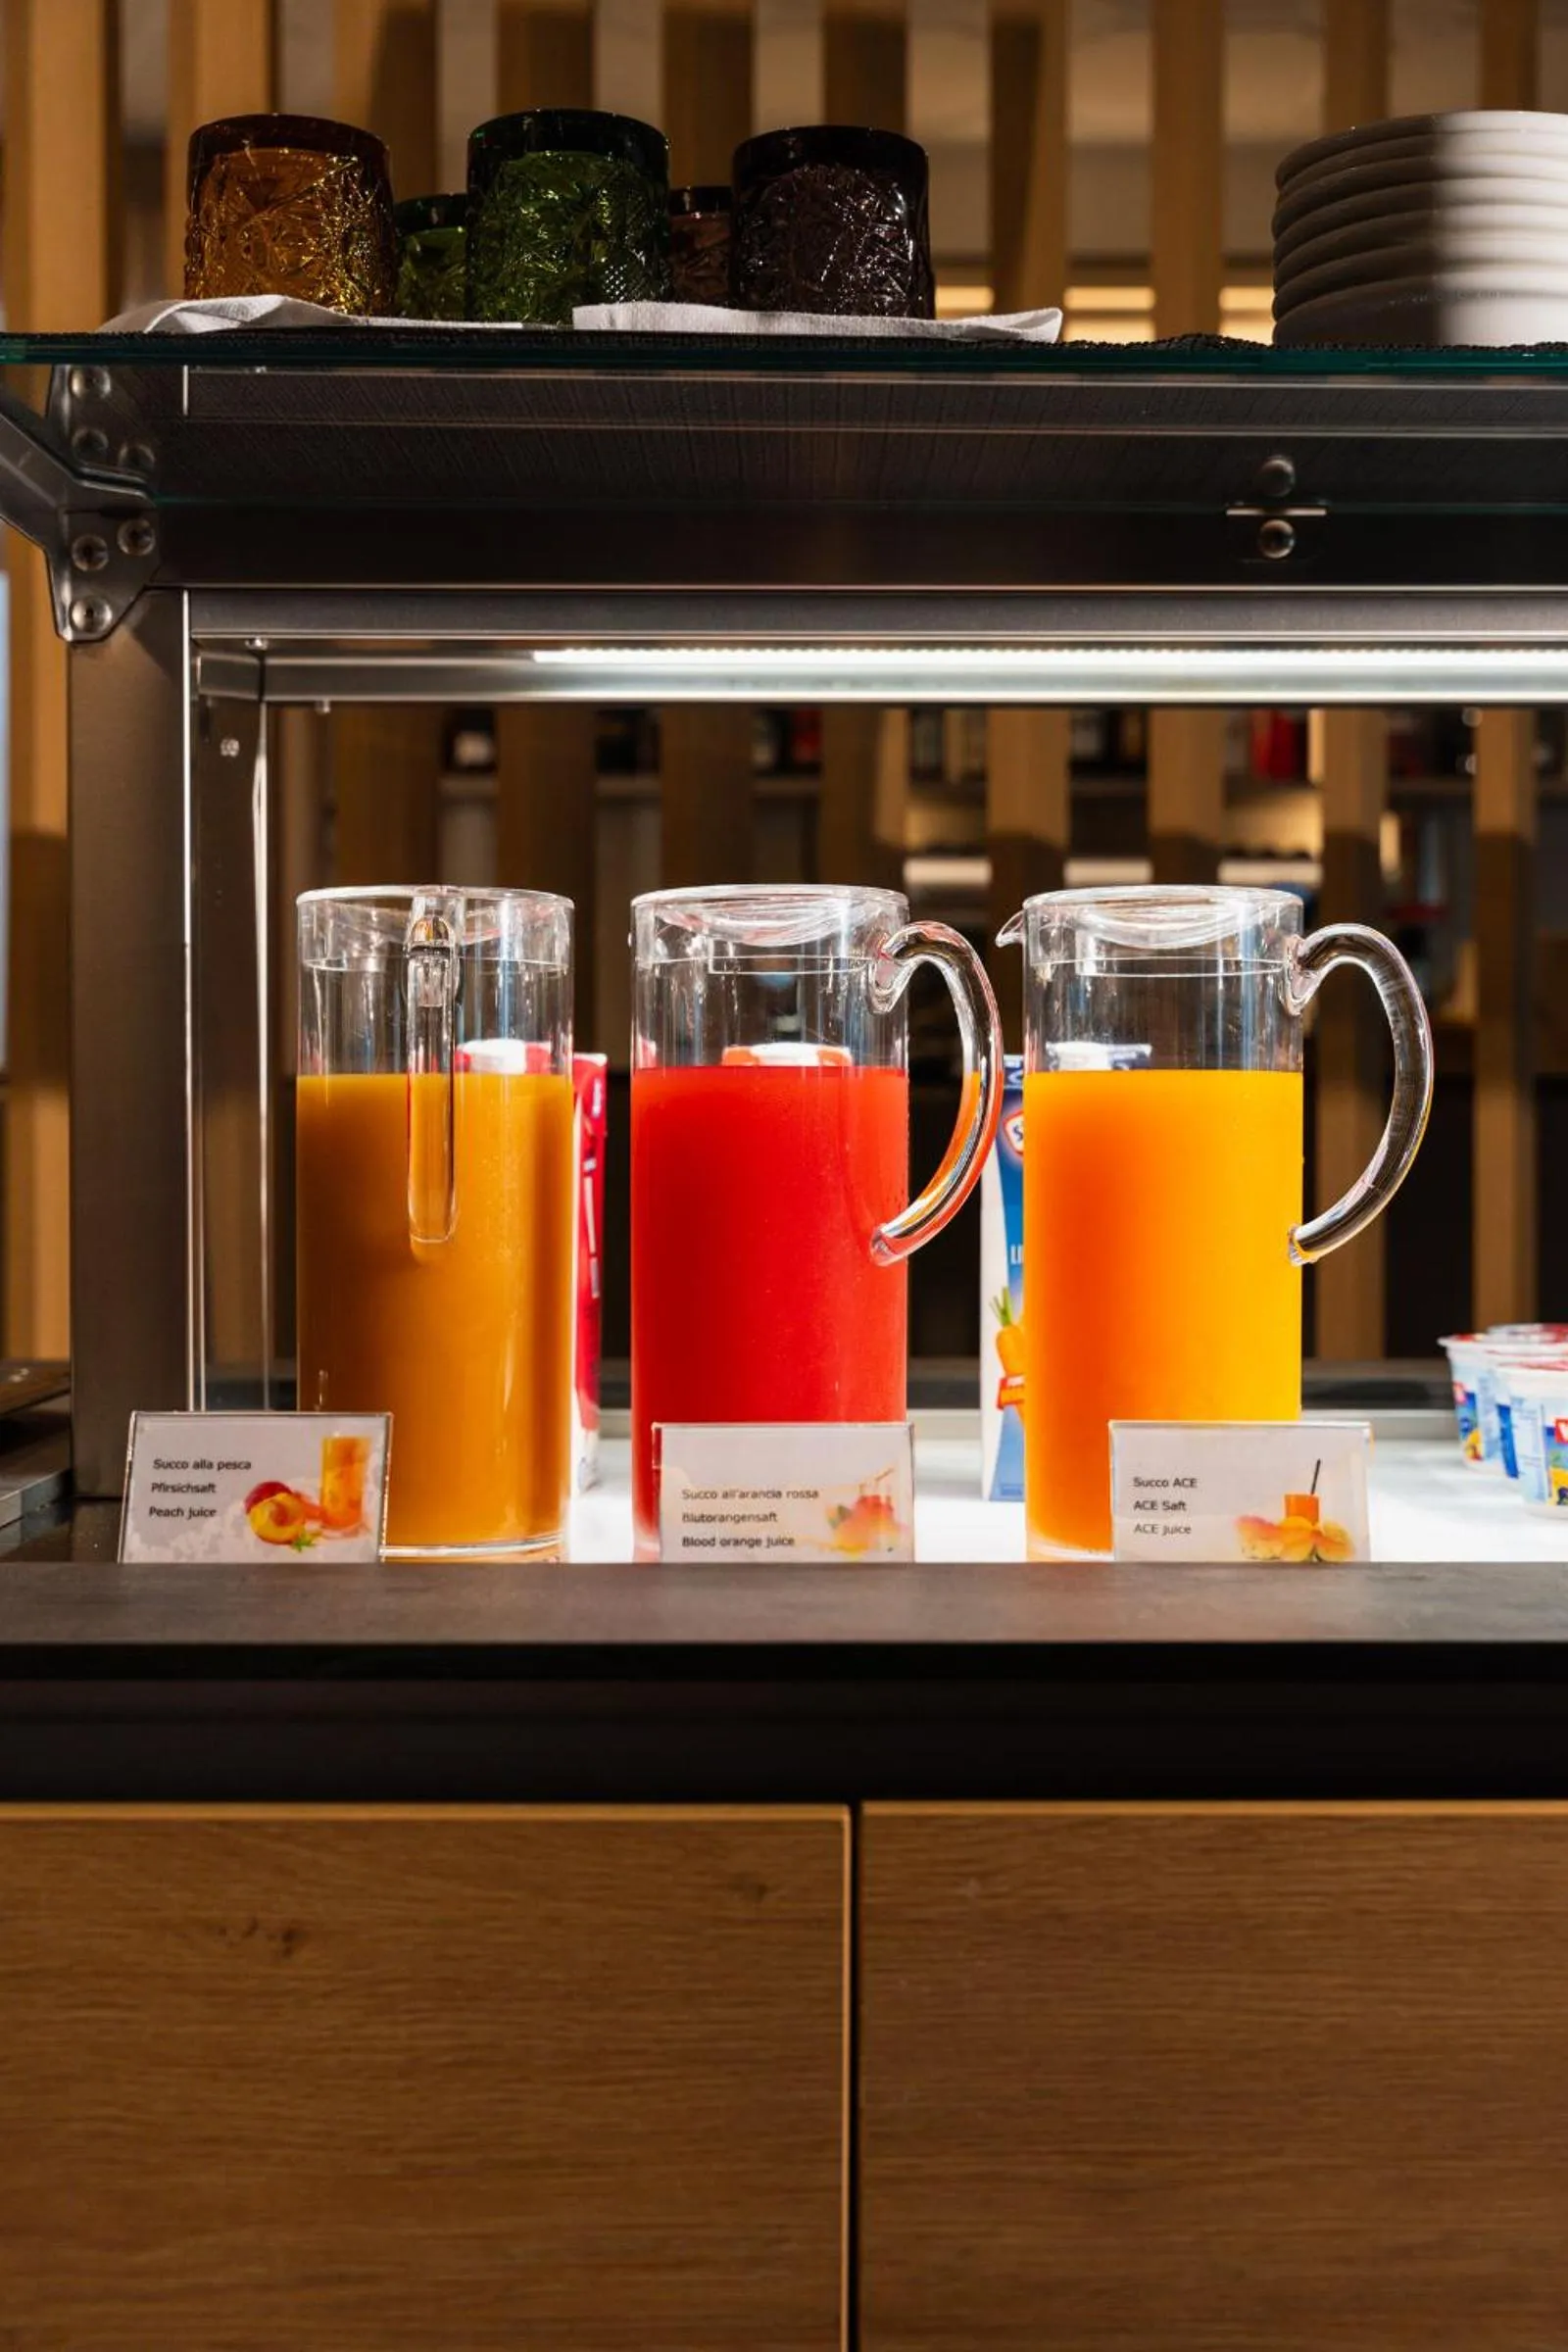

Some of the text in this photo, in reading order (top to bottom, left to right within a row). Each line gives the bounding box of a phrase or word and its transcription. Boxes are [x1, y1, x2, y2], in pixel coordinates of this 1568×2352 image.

[153, 1458, 252, 1472] Succo alla pesca
[151, 1482, 217, 1494] Pfirsichsaft
[1133, 1476, 1198, 1489] Succo ACE
[682, 1489, 717, 1499] Succo
[786, 1490, 819, 1499] rossa
[1134, 1499, 1187, 1511] ACE Saft
[149, 1505, 217, 1520] Peach juice
[682, 1511, 777, 1524] Blutorangensaft
[1133, 1523, 1192, 1537] ACE juice
[682, 1536, 795, 1548] Blood orange juice
